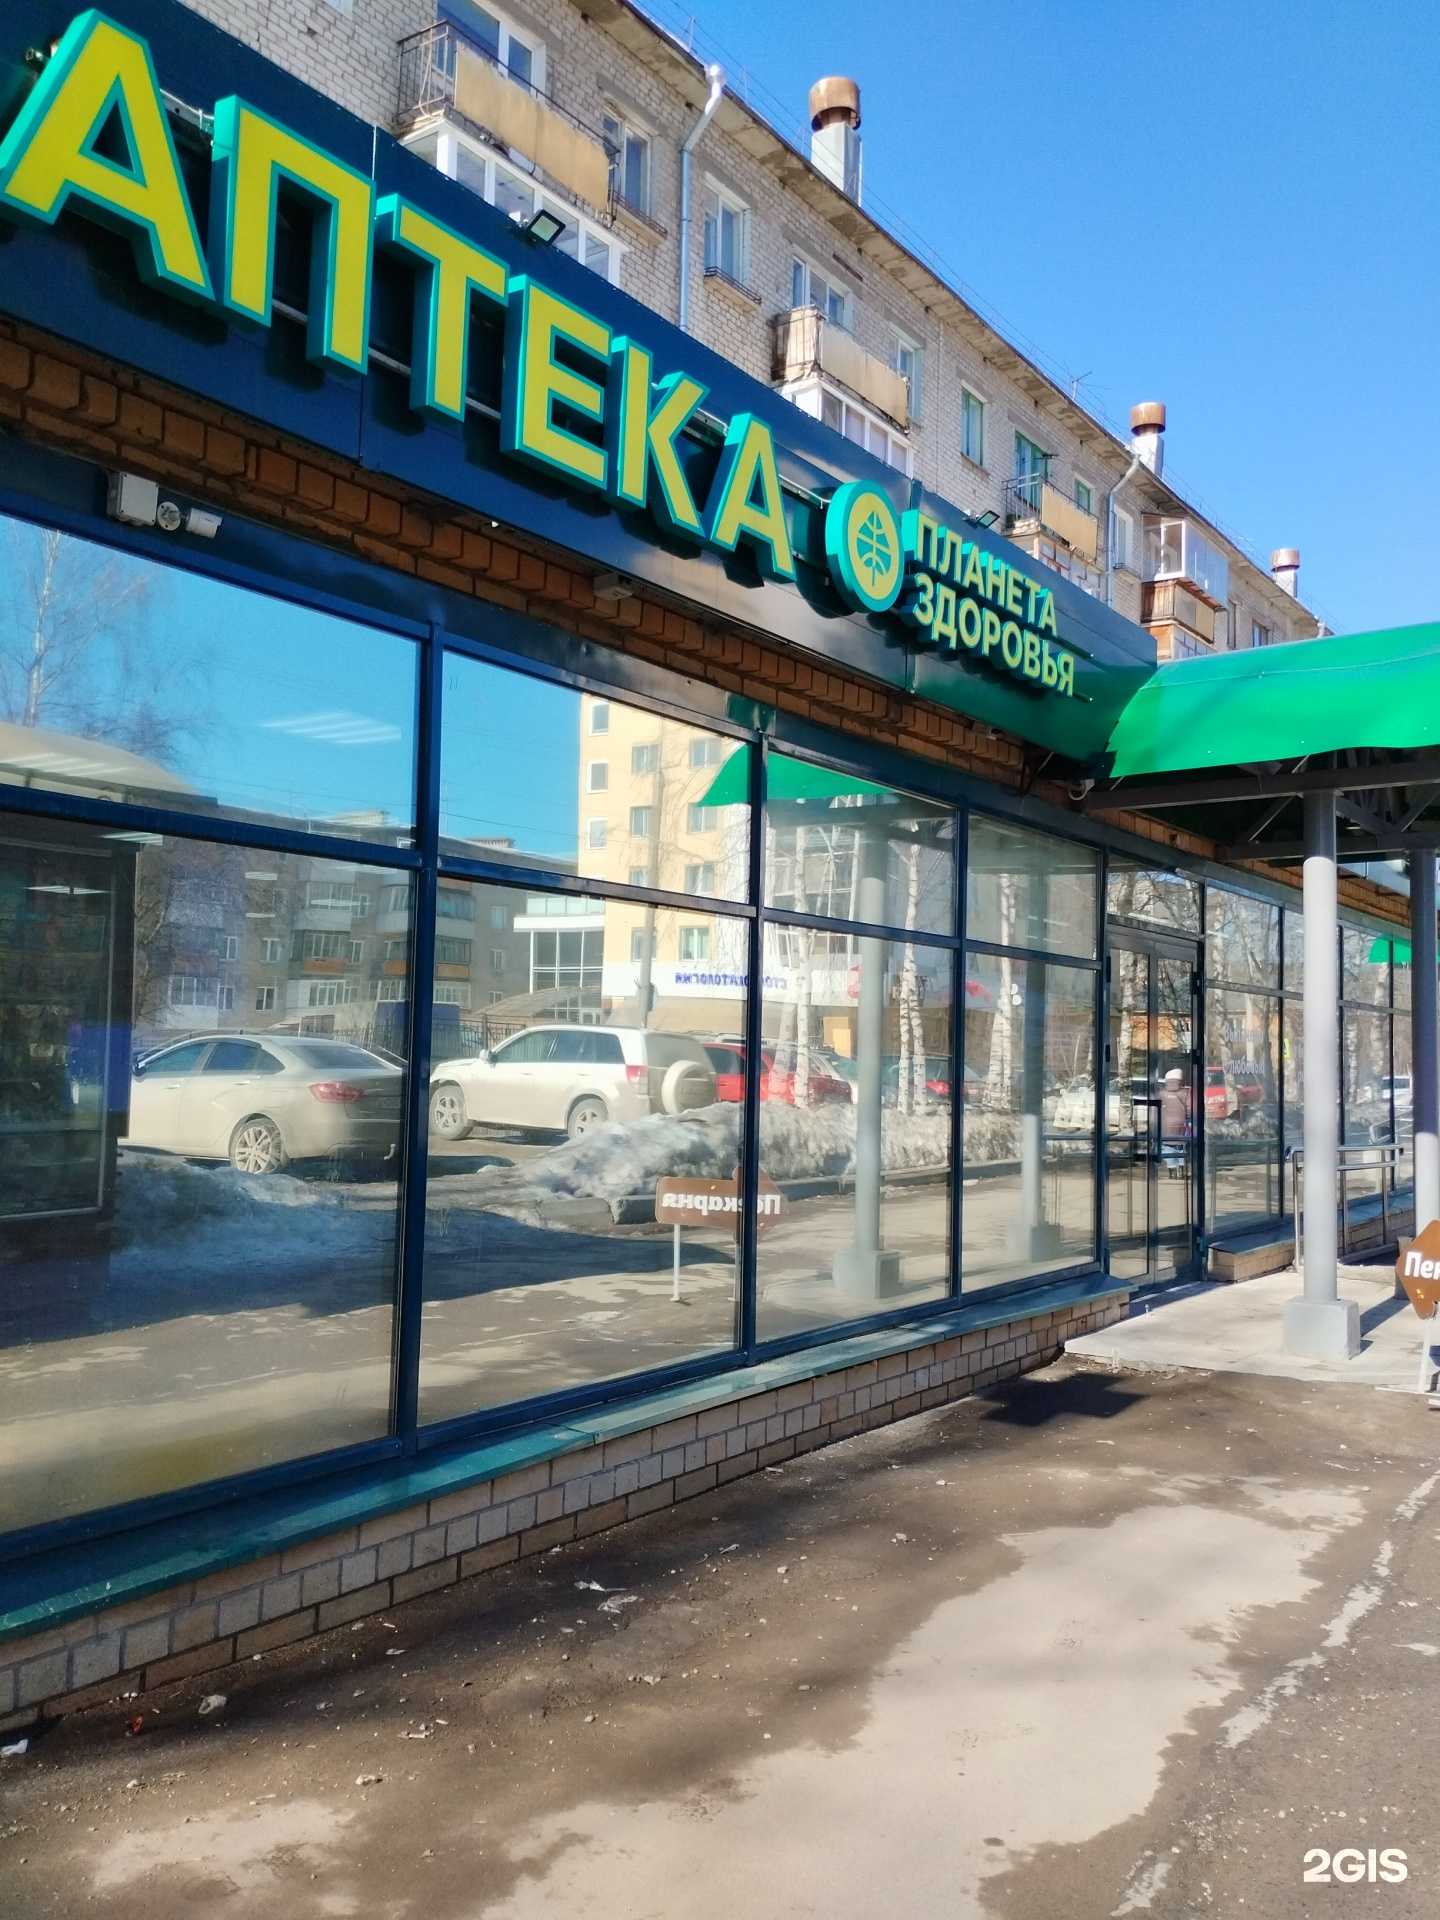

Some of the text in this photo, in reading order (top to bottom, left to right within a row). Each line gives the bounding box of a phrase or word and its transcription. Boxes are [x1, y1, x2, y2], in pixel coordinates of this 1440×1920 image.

[0, 10, 797, 583] АПТЕКА
[907, 511, 1058, 637] ПЛАНЕТА
[912, 572, 1075, 697] ЗДОРОВЬЯ
